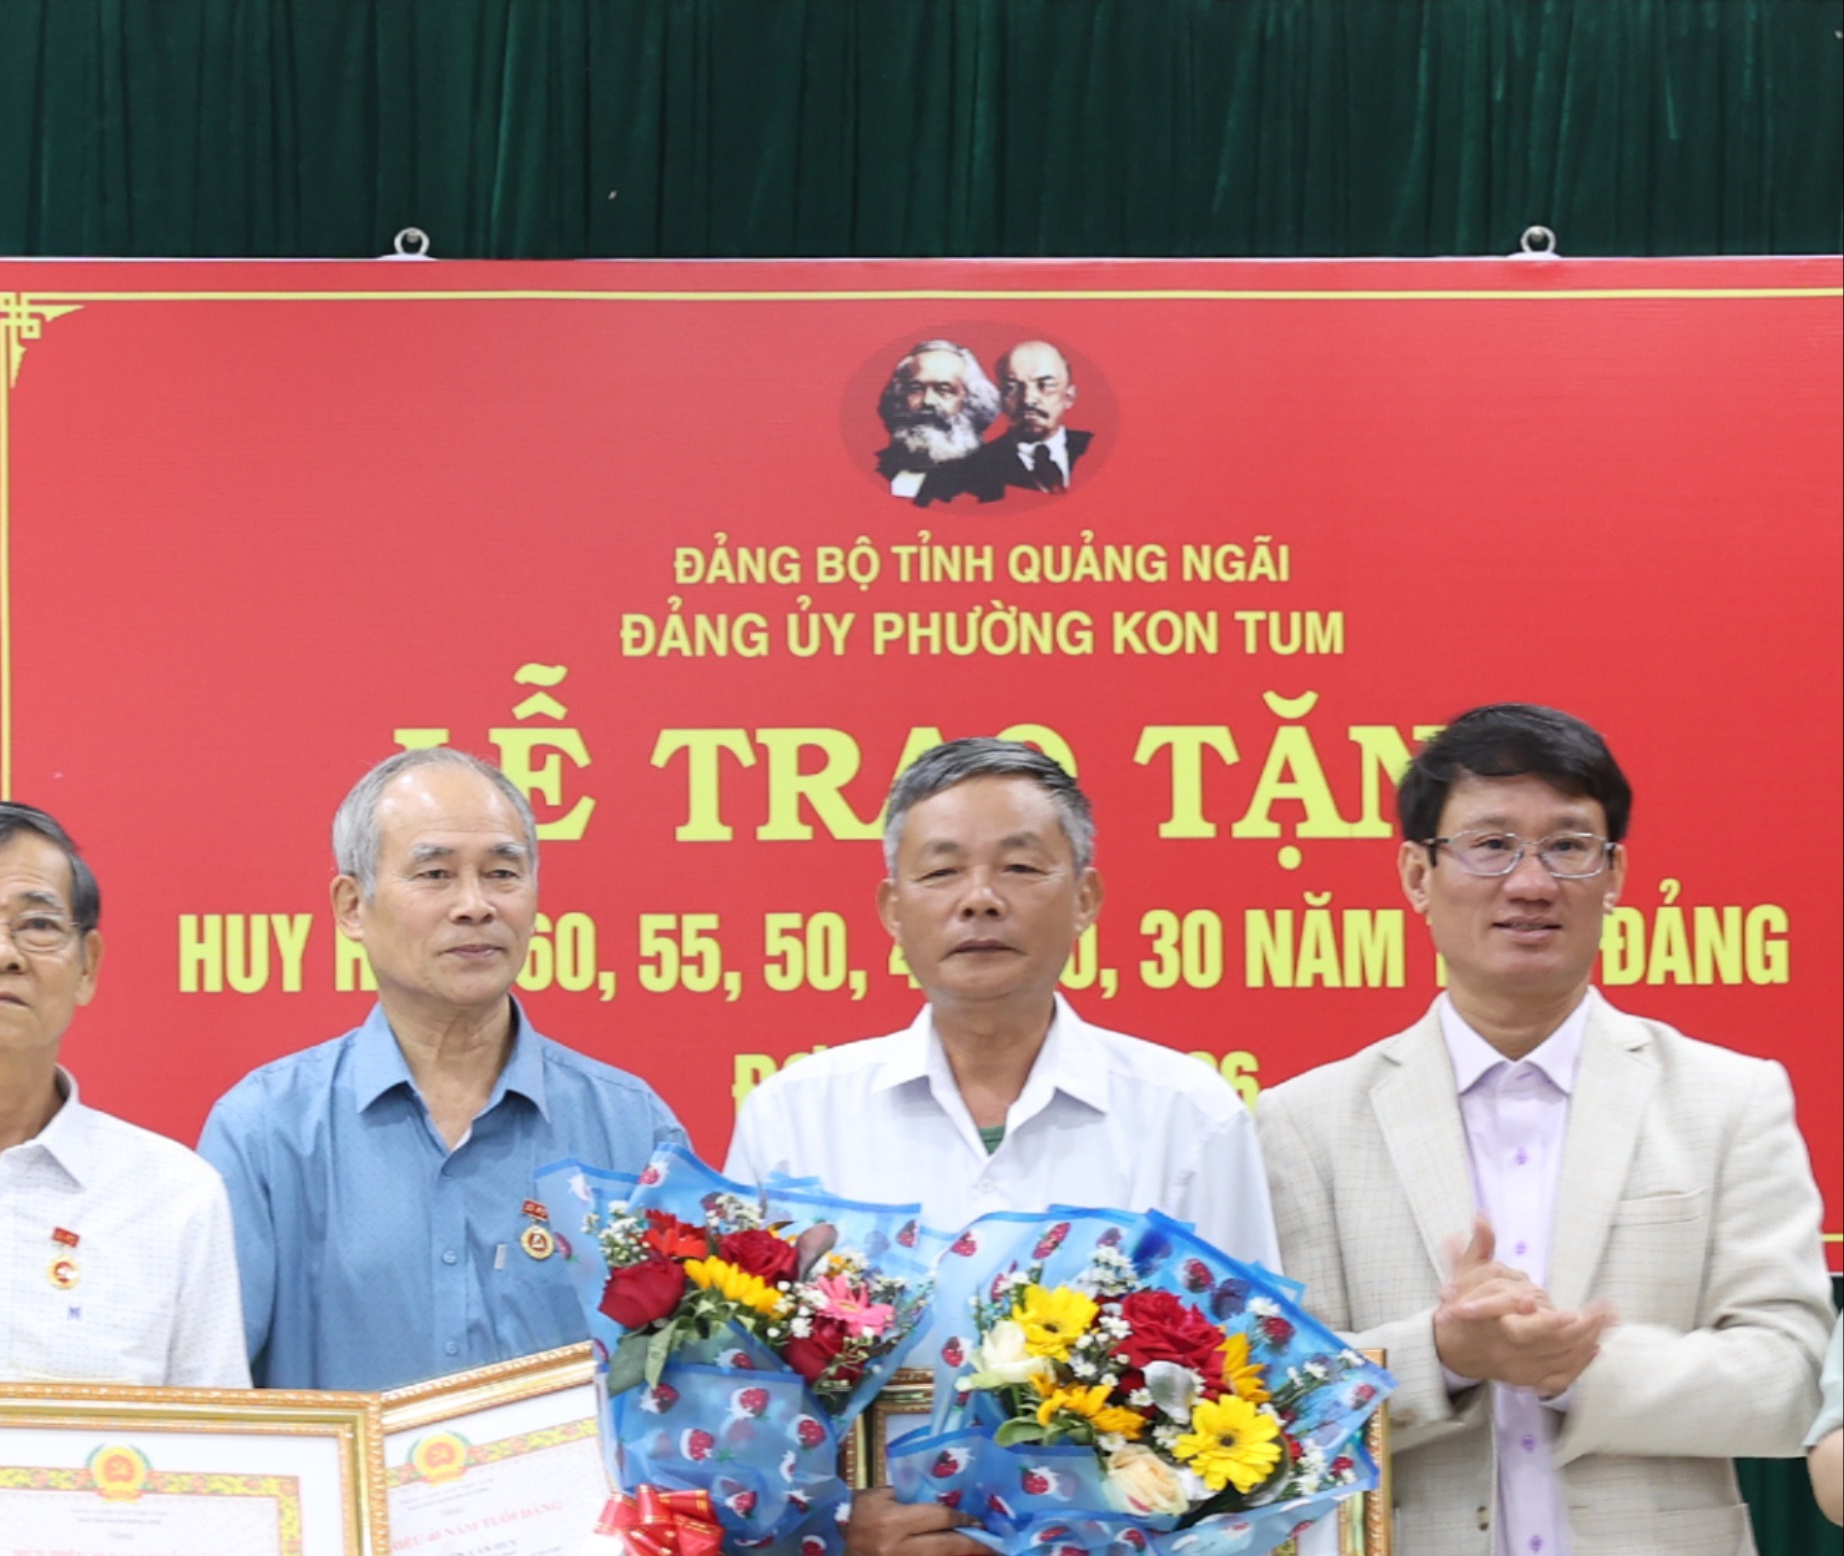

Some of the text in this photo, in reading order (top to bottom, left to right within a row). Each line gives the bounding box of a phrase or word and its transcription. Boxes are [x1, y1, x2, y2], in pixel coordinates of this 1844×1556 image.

[673, 530, 1289, 591] ĐẢNG BỘ TỈNH QUẢNG NGÃI
[620, 595, 1344, 657] ĐẢNG ỦY PHƯỜNG KON TUM
[394, 663, 1447, 870] Ễ TR TẶN
[179, 914, 312, 993] HUY
[515, 912, 616, 1002] 60,
[638, 914, 742, 1002] 55,
[764, 912, 867, 1001] 50,
[1140, 909, 1223, 989] 30
[1245, 892, 1406, 988] NĂM
[1599, 878, 1789, 986] ĐẢNG
